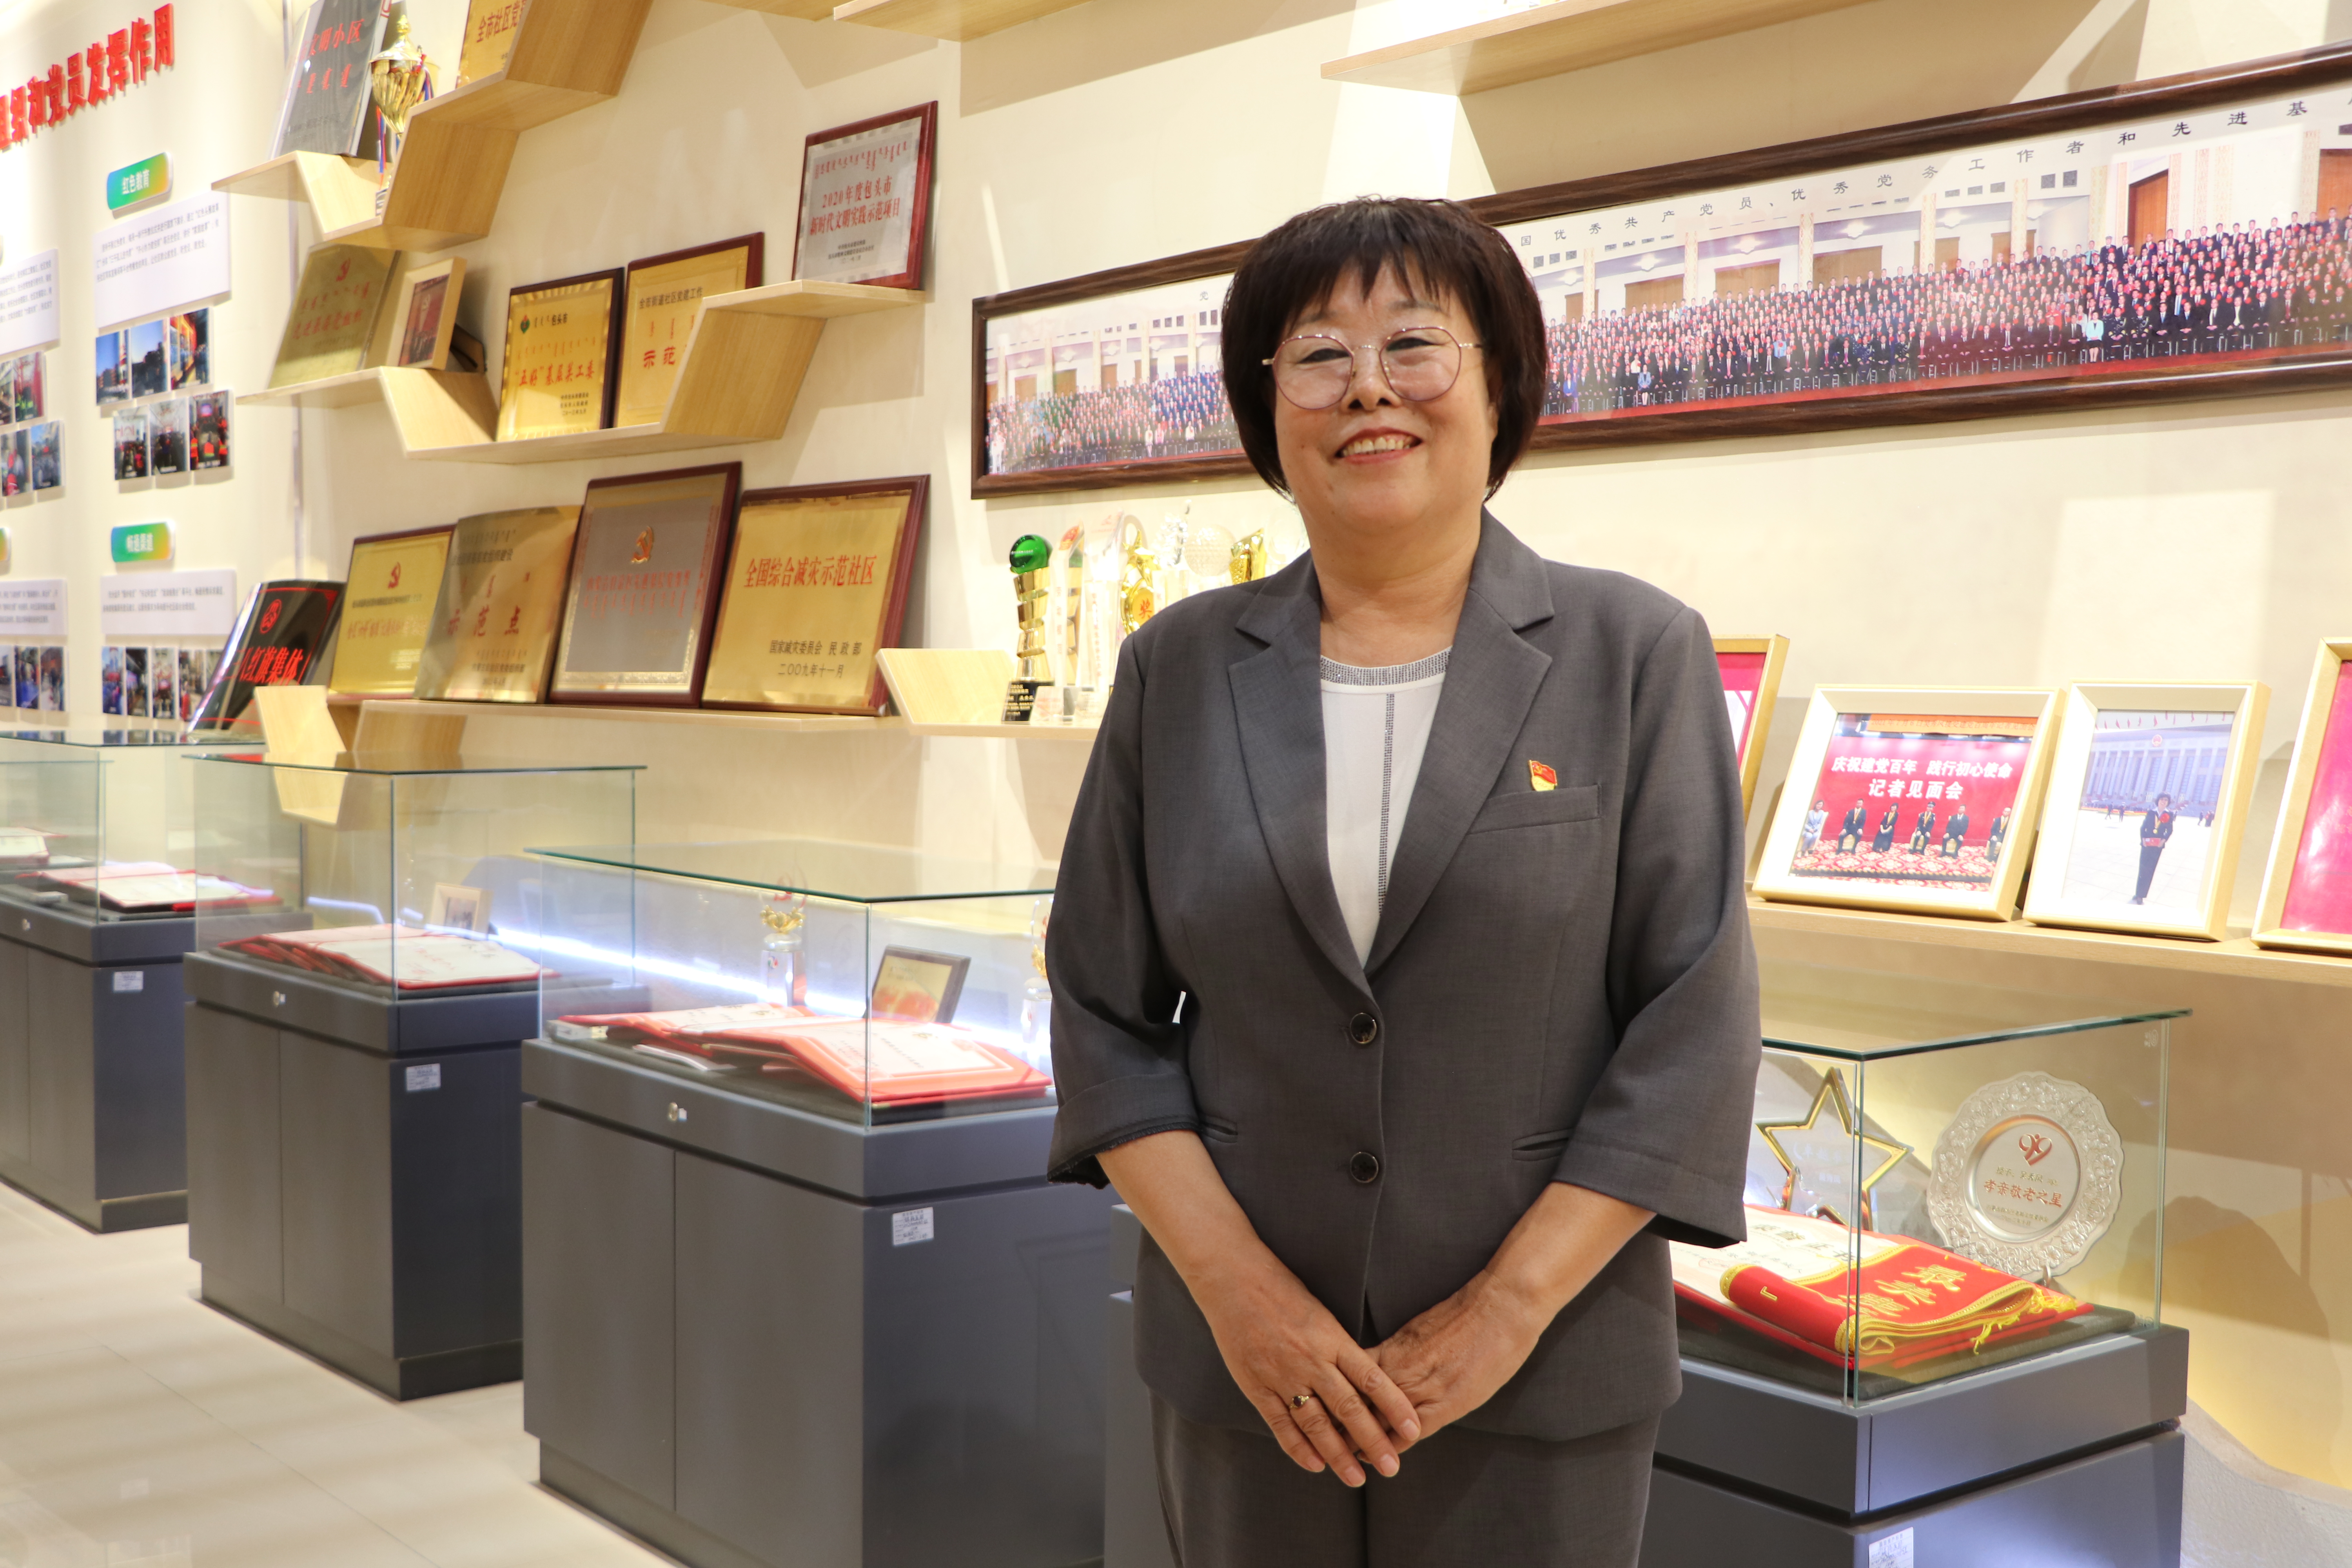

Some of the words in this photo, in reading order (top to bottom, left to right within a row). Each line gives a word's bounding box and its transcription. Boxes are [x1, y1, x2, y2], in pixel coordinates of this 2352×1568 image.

[1199, 290, 1209, 301] 党
[1520, 87, 2352, 246] 国优秀共产党员、优秀党务工作者和先进基
[810, 197, 900, 236] 新时代文明实践示范项目
[639, 287, 703, 309] 全市街道社区党建工作
[552, 312, 568, 326] 包头市
[744, 554, 877, 588] 全国综合减灾示范社区
[1139, 598, 1152, 620] 奖
[769, 640, 822, 655] 国家减灾委员会
[1831, 756, 1918, 775] 庆祝建党百年
[1926, 760, 2013, 778] 践行初心使命
[1868, 778, 1964, 800] 记者见面会
[1984, 1178, 2063, 1208] 孝亲敬老之星
